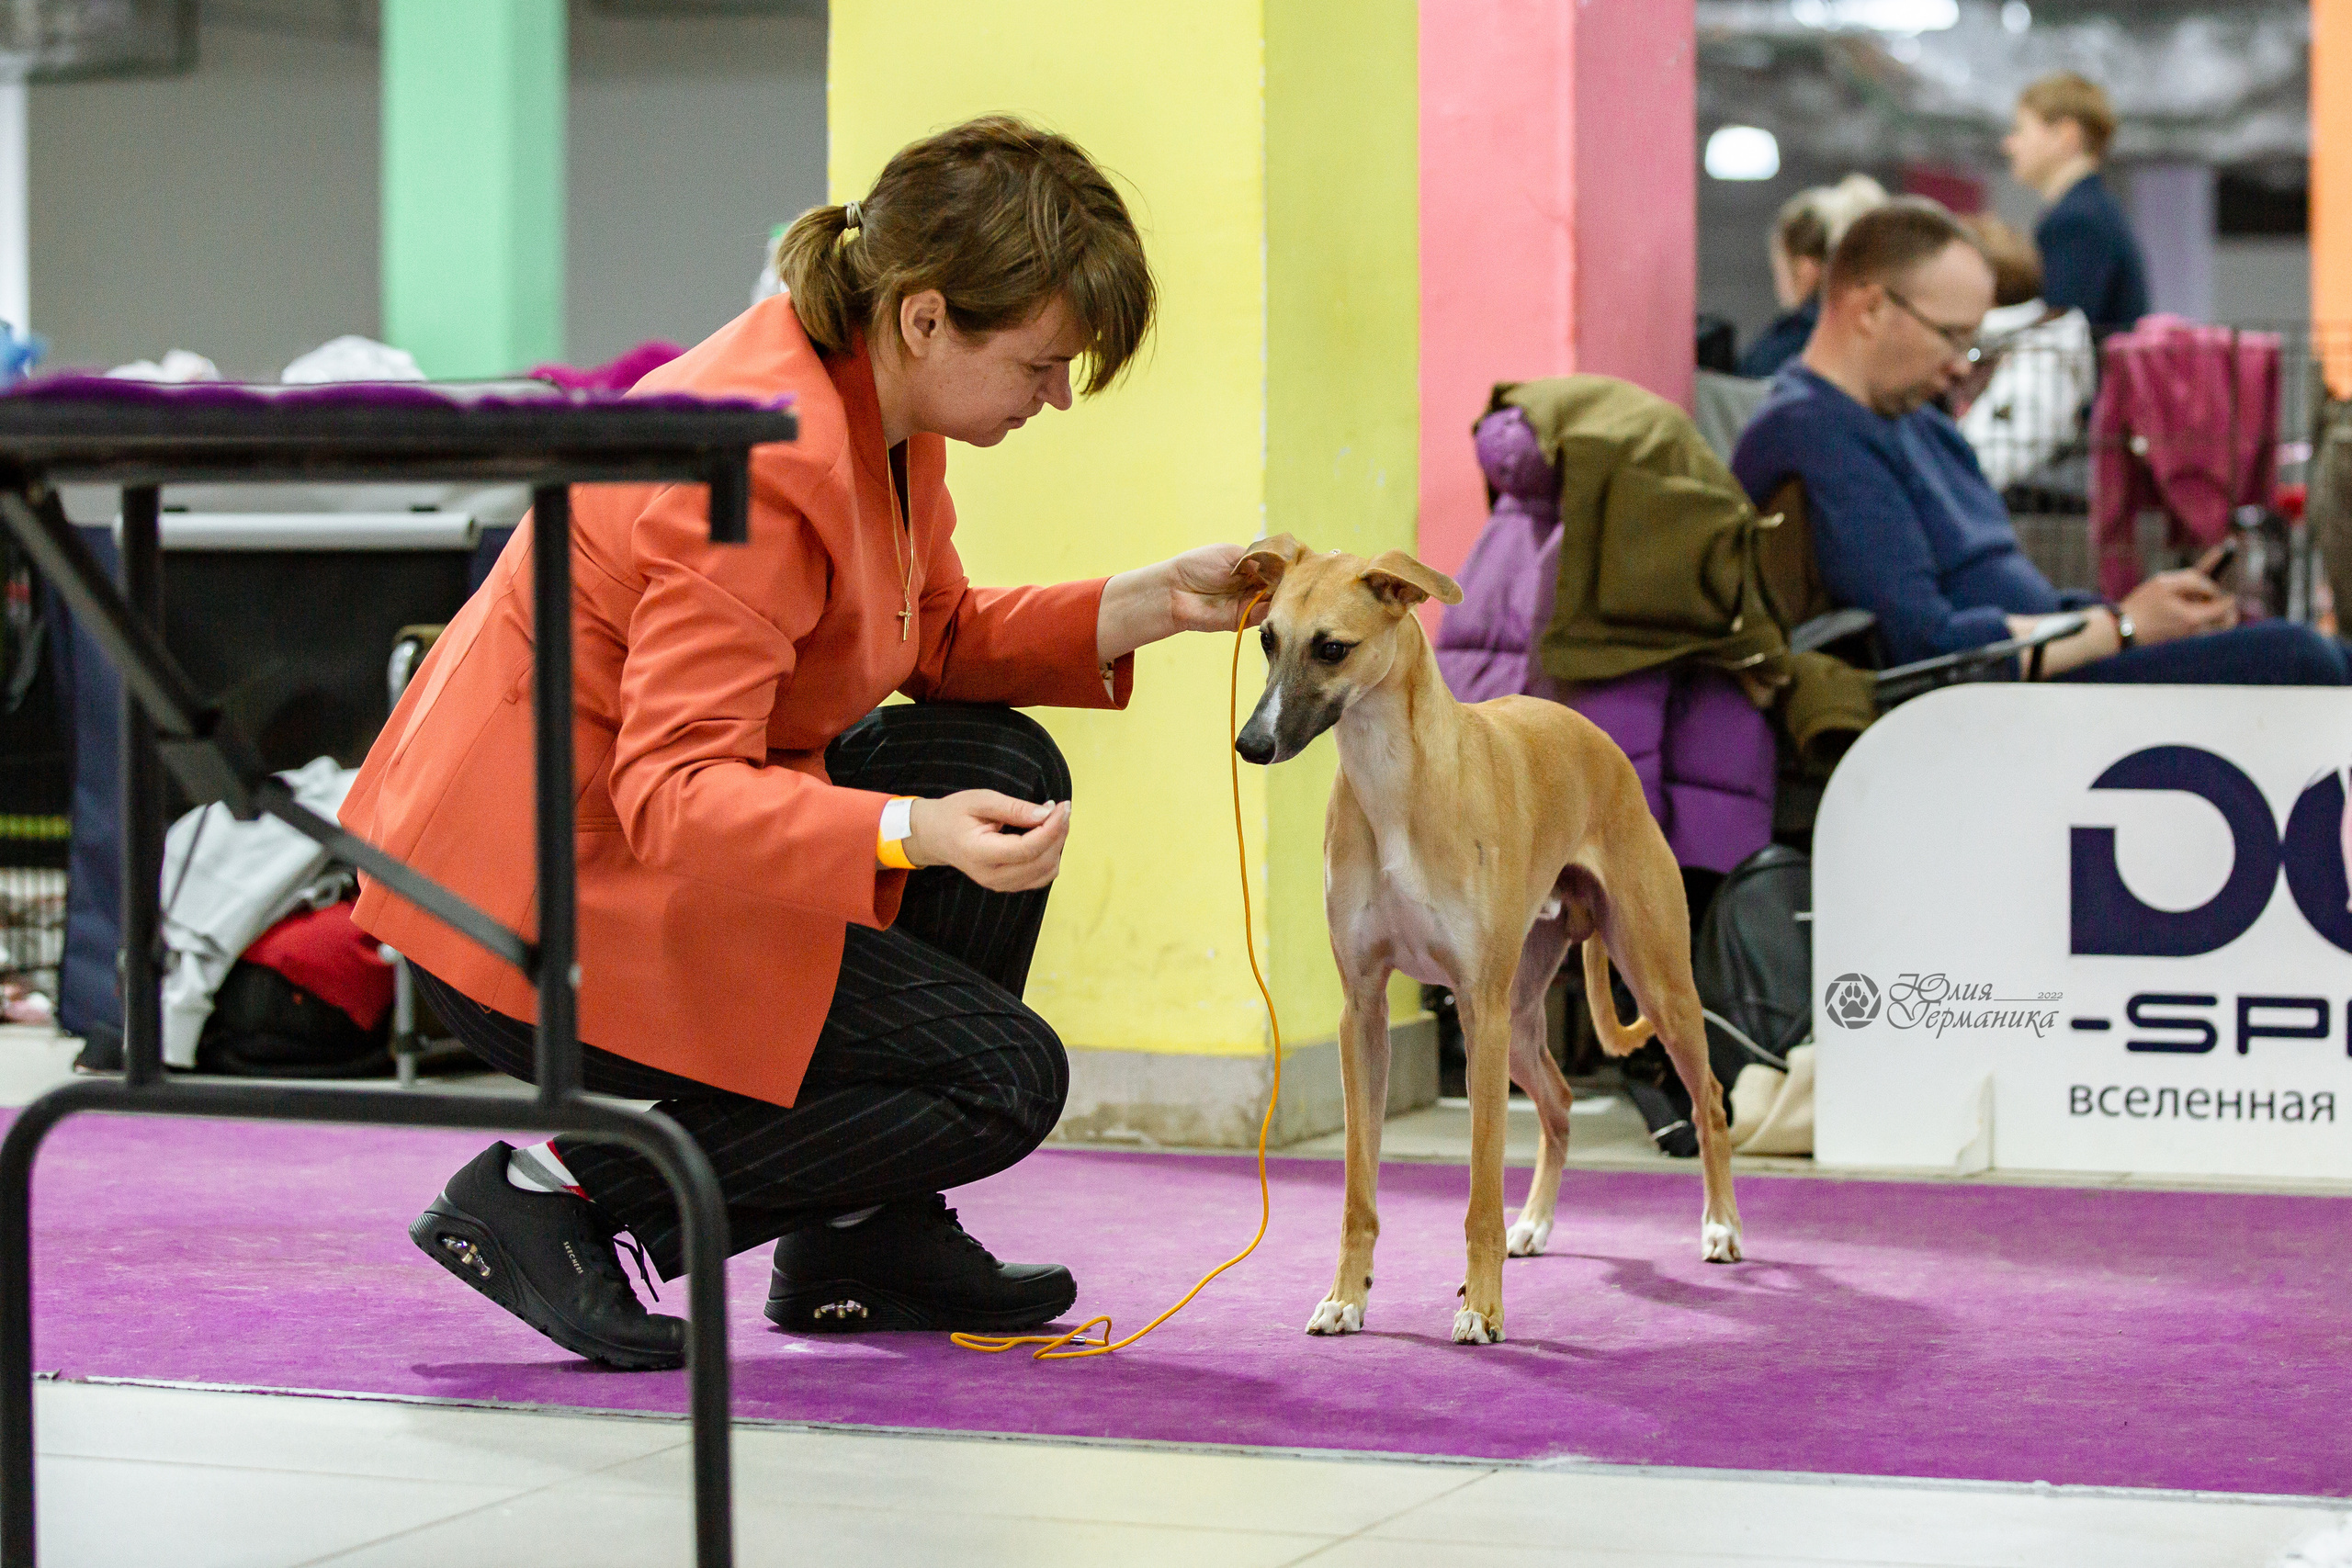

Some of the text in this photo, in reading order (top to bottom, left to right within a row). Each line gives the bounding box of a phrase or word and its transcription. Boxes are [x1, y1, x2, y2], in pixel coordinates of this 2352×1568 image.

[2070, 992, 2352, 1058] -SP
[2069, 1085, 2336, 1122] вселенная
[563, 1241, 584, 1274] SKECHERS
